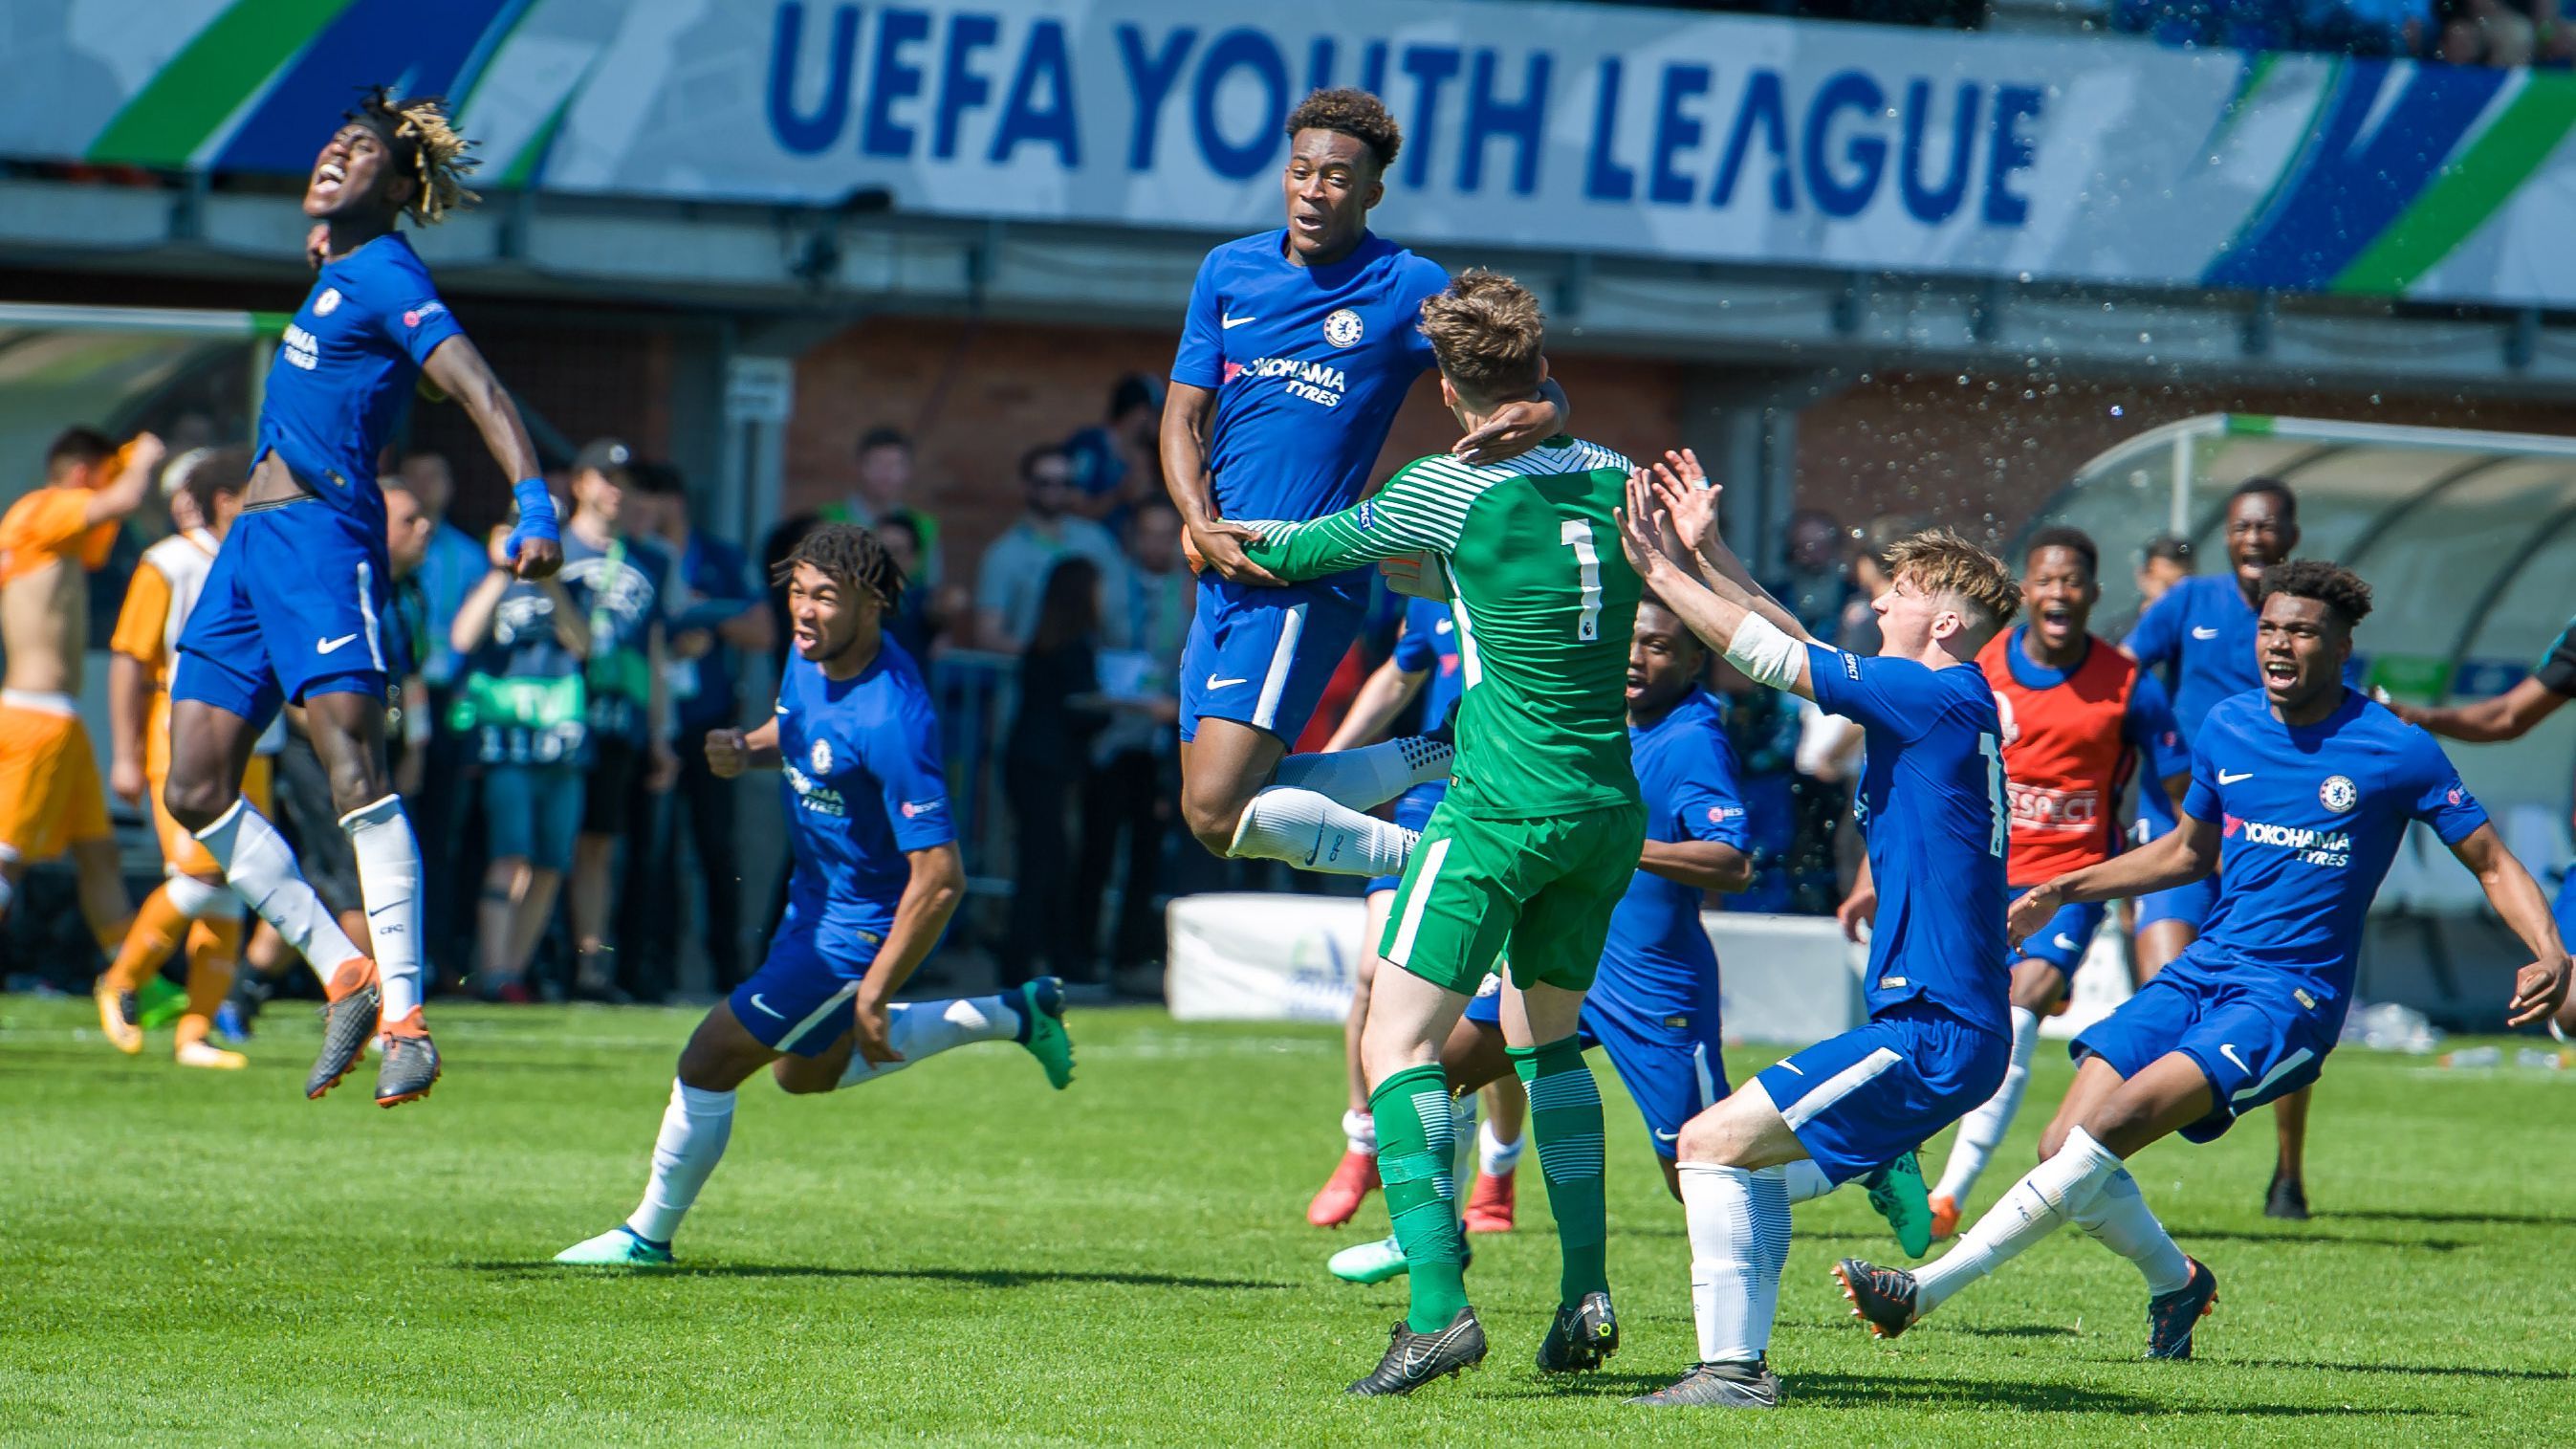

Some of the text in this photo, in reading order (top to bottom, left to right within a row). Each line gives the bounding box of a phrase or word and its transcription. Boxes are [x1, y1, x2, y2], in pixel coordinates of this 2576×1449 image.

[766, 0, 1082, 170] UEFA
[1583, 55, 2044, 229] LEAGUE
[1236, 357, 1345, 392] OKOHAMA
[1285, 380, 1341, 407] TYRES
[1561, 518, 1603, 641] 1
[1978, 732, 2012, 858] 1
[2008, 790, 2097, 823] ESPECT
[2243, 822, 2351, 851] YOKOHAMA
[2296, 848, 2350, 867] TYRES
